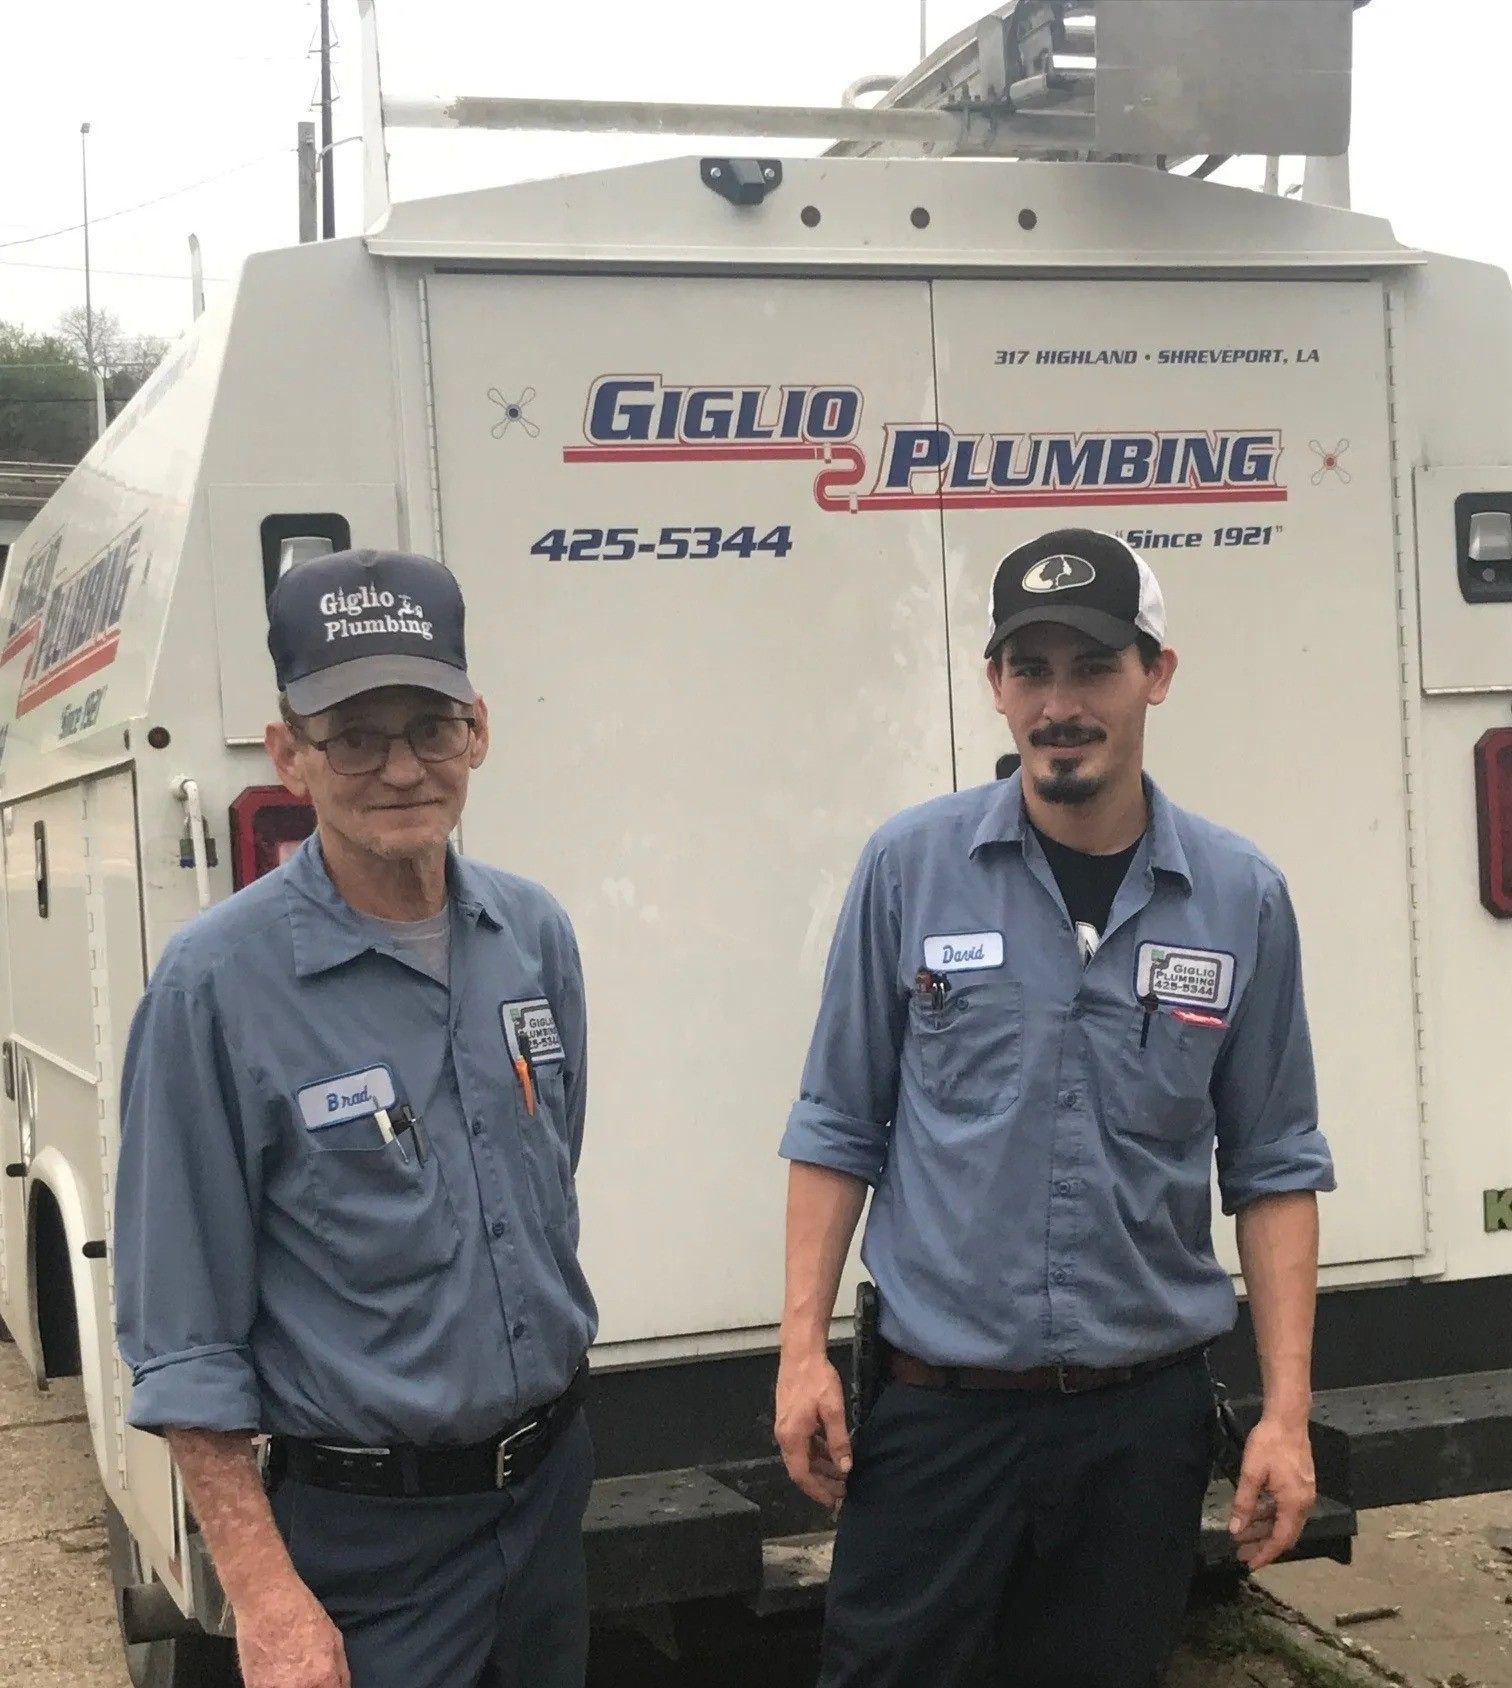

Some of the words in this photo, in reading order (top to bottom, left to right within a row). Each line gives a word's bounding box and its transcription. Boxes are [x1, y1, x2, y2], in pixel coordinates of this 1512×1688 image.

[994, 351, 1029, 366] 317
[1035, 350, 1138, 364] HIGHLAND
[1158, 349, 1290, 365] SHREVEPORT,
[1296, 349, 1320, 363] LA
[585, 374, 863, 444] GIGLIO
[876, 424, 1282, 492] PLUMBING
[530, 525, 793, 562] 425-5344
[320, 582, 395, 616] Giglio
[324, 614, 433, 642] Plumbing
[942, 944, 985, 964] David
[1156, 970, 1215, 987] PLUMBING
[1173, 964, 1215, 978] GIGLIO
[1154, 980, 1213, 995] 425-5344
[326, 1083, 373, 1112] Brad
